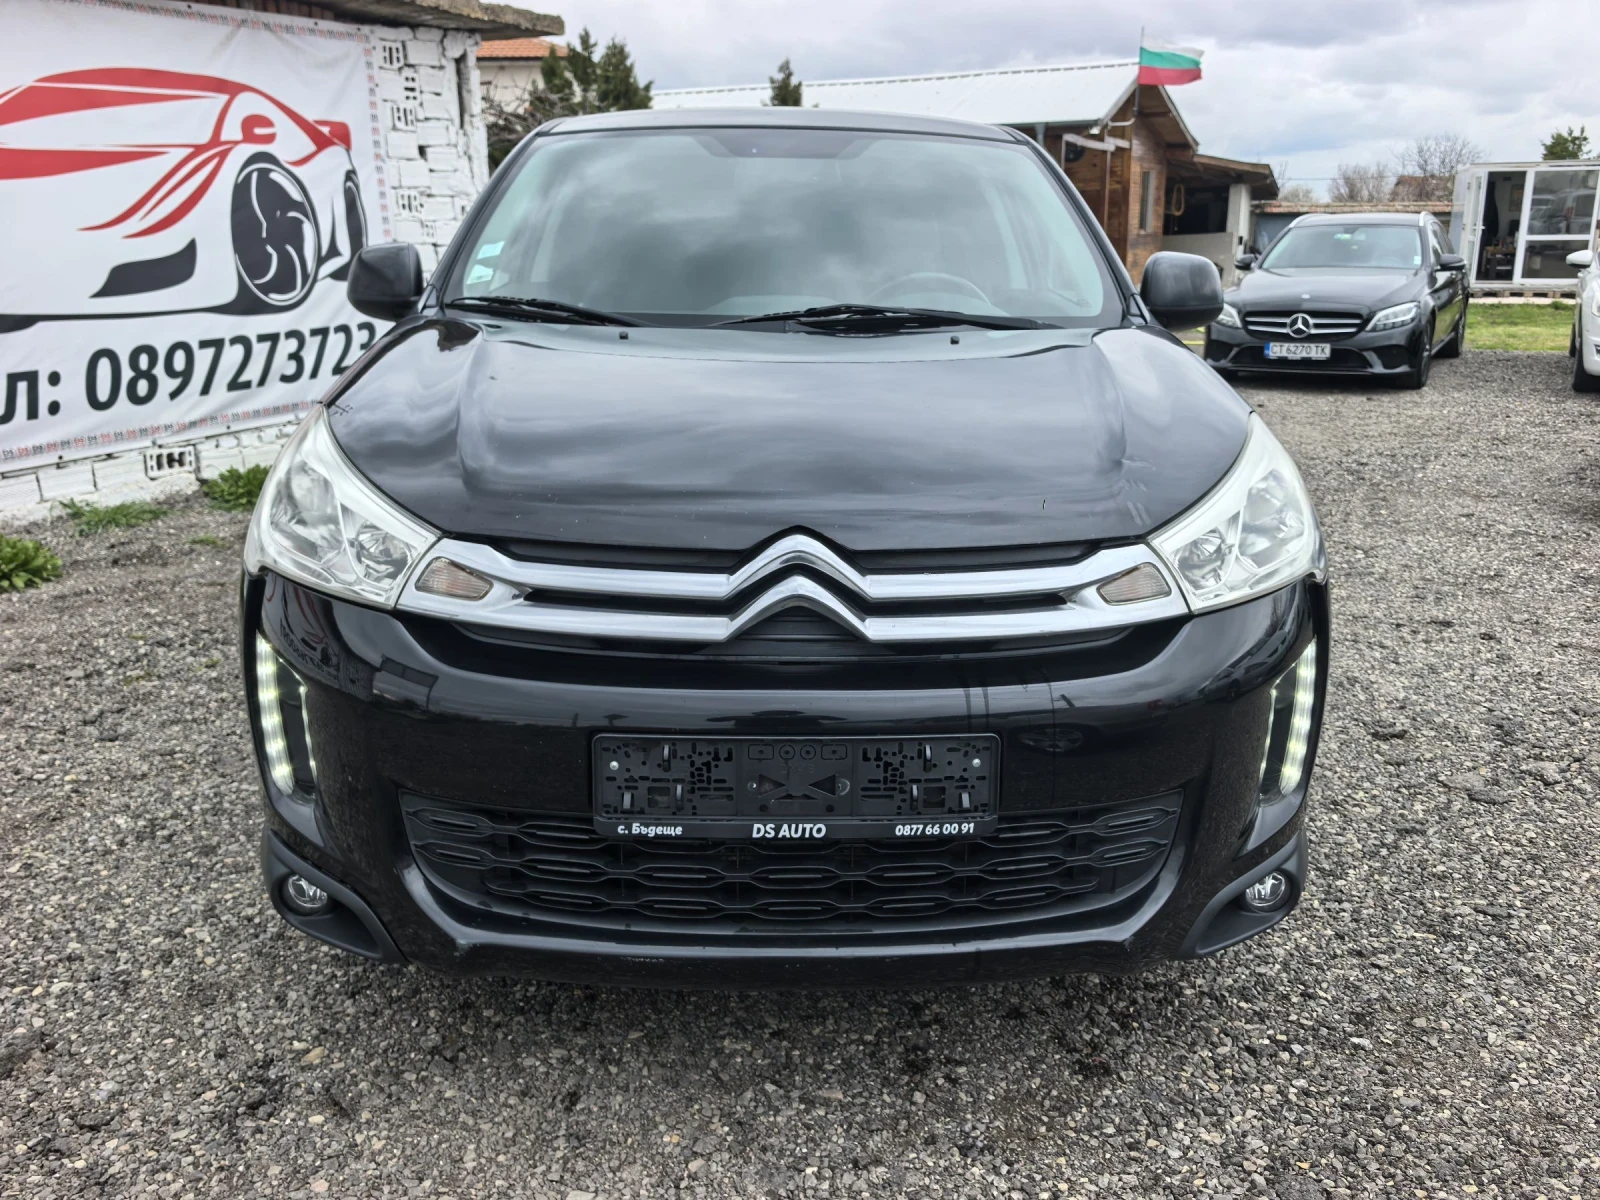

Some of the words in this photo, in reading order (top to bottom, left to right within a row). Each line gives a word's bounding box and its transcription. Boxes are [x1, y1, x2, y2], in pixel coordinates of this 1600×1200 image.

[1270, 344, 1285, 355] CT
[1286, 344, 1312, 355] 6270
[1314, 345, 1328, 356] TK
[631, 822, 683, 837] Бъдеще
[751, 823, 776, 838] DS
[777, 823, 827, 838] AUTO
[895, 824, 924, 836] 0877
[925, 823, 940, 835] 66
[942, 823, 959, 835] 00
[960, 822, 975, 834] 91
